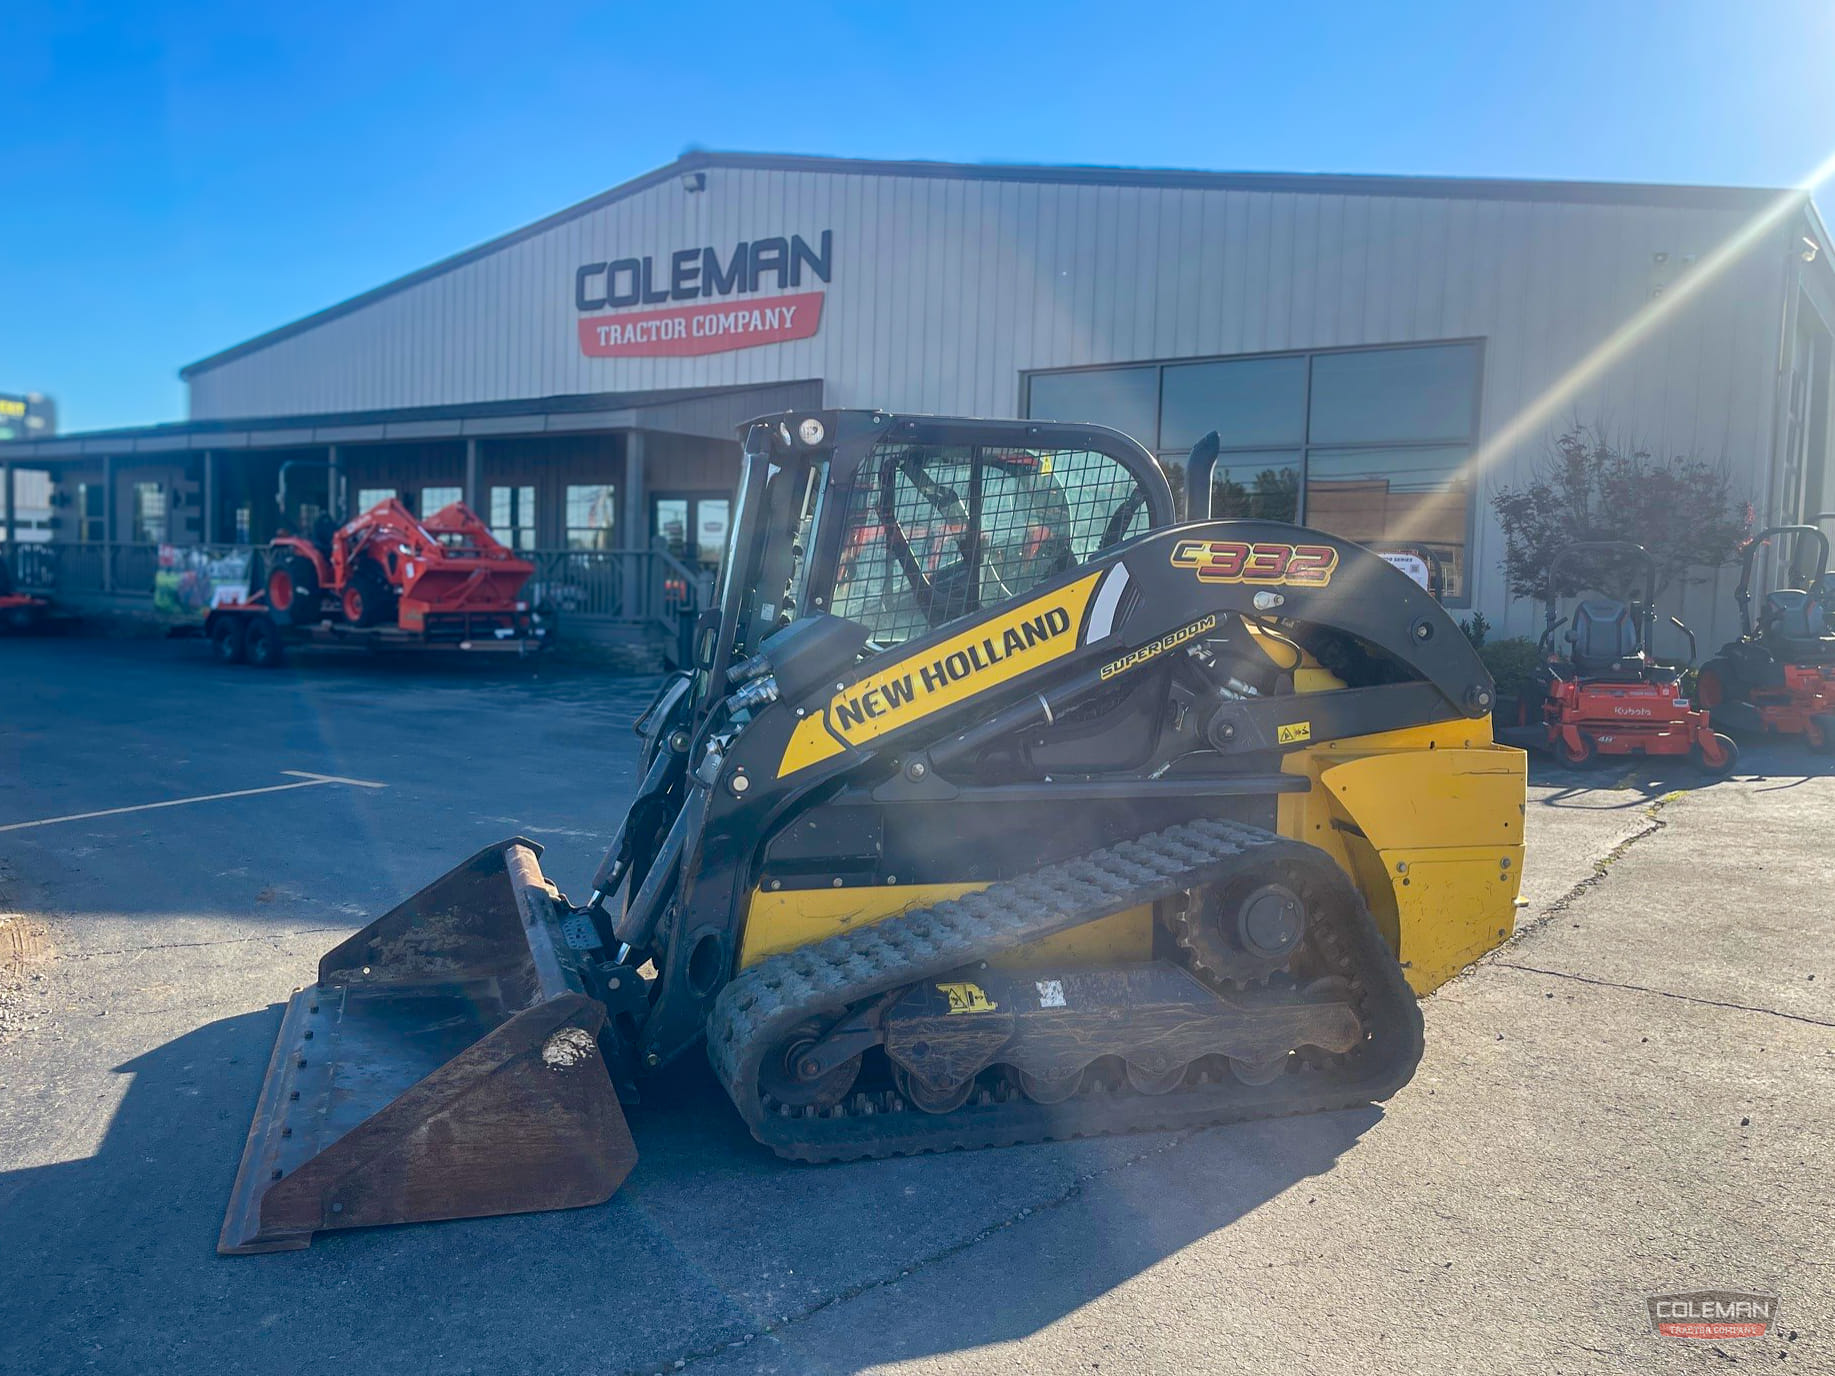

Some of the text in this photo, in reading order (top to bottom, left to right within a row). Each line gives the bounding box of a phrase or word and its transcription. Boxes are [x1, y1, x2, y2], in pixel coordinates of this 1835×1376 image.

[575, 229, 833, 311] COLEMAN
[597, 306, 797, 347] TRACTOR COMPANY
[1171, 540, 1339, 587] C332
[835, 606, 1072, 731] NEW HOLLAND
[1101, 614, 1216, 679] SUPER BOOM
[1614, 706, 1652, 717] Kubota
